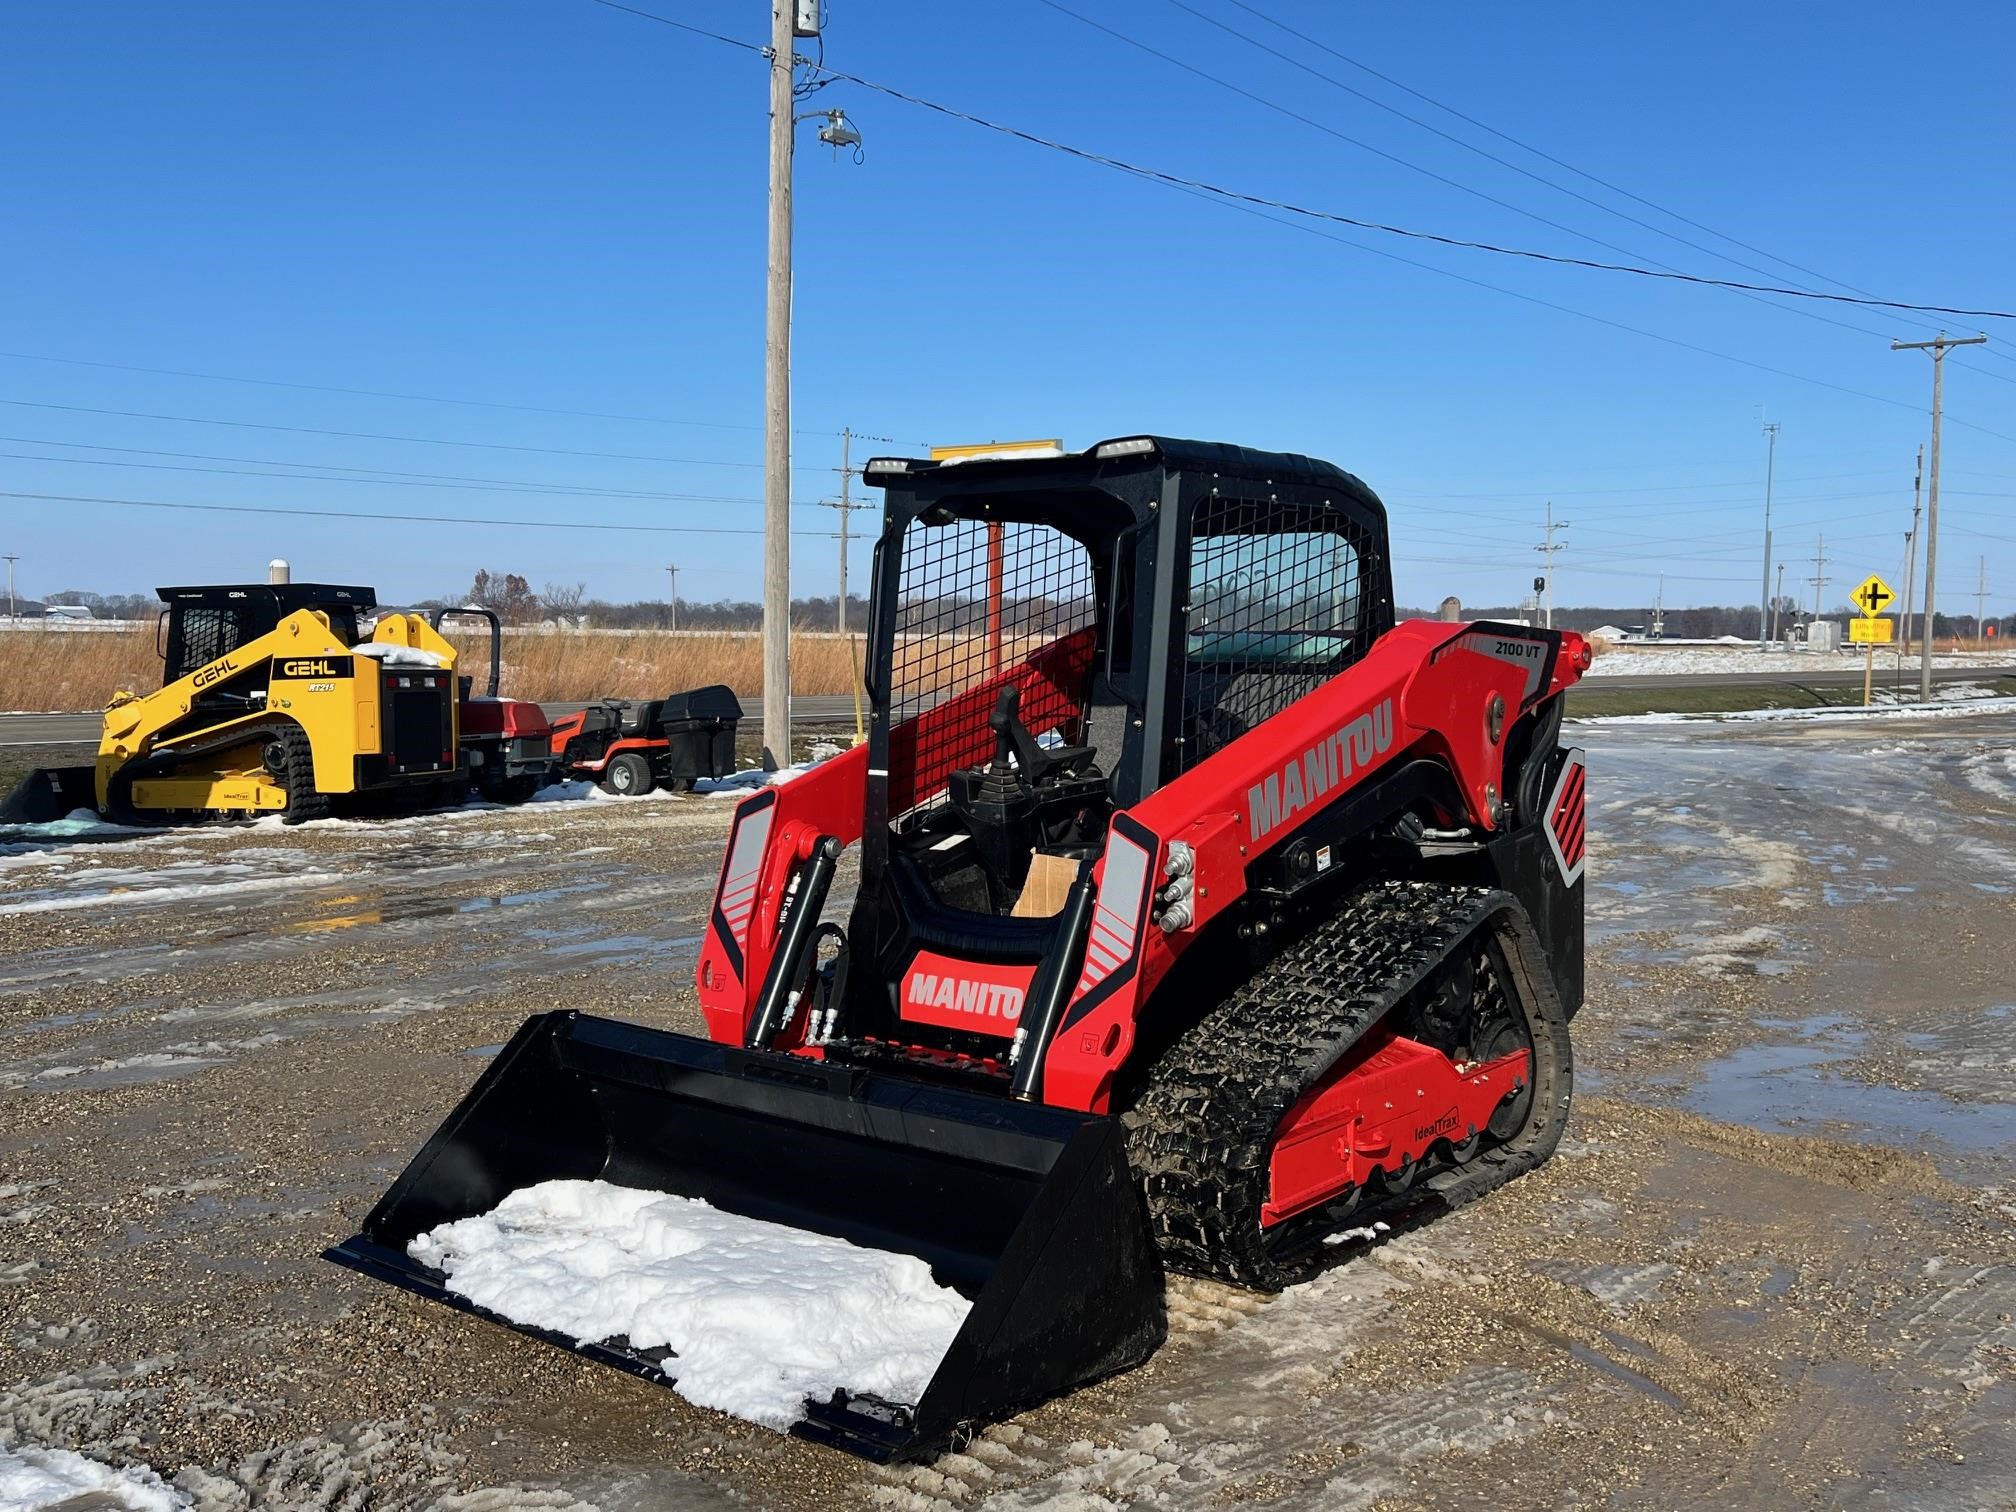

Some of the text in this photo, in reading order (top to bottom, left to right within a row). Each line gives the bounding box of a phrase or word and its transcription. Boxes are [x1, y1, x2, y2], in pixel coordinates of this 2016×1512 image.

[1495, 641, 1541, 659] 2100 VT
[192, 659, 239, 688] GEHL
[284, 660, 337, 676] GEHL
[1247, 697, 1393, 844] MANITOU
[908, 972, 1024, 1020] MANITO
[1414, 1115, 1458, 1142] IdealTrax
